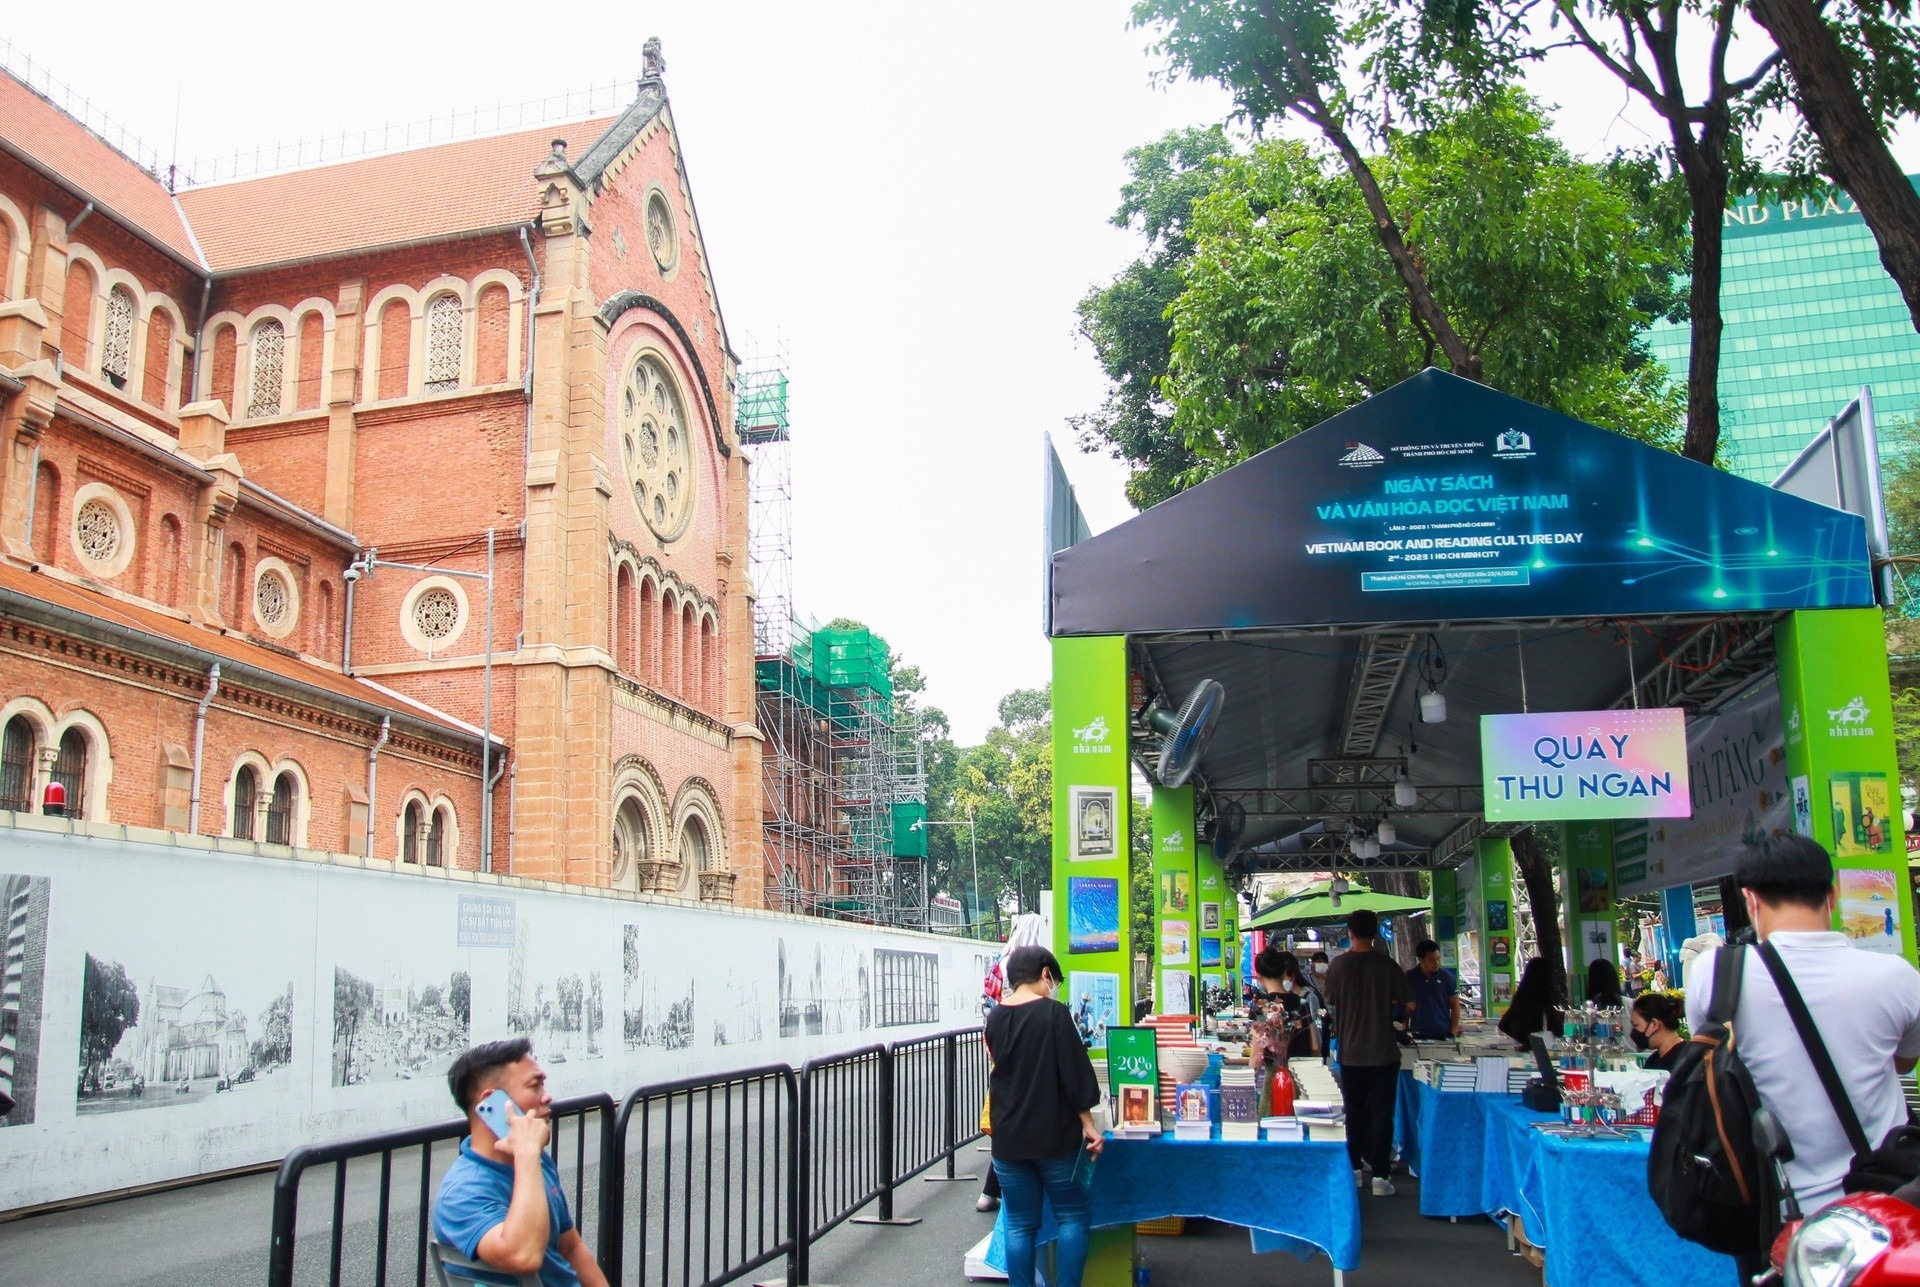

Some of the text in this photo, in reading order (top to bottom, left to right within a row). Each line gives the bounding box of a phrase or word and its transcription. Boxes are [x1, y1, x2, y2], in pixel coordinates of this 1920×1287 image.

[1723, 194, 1861, 227] ND PLAZ
[1384, 474, 1494, 494] NGÀY SÁCH
[1316, 494, 1568, 520] VÀ VĂN HÓA ĐỌC VIỆT NAM
[1306, 533, 1583, 554] VIETNAM BOOK AND READING CULTURE DAY
[1851, 727, 1874, 736] nam
[1092, 745, 1111, 754] nam
[1496, 768, 1672, 800] THU NGÂN
[1690, 747, 1712, 810] UÀ
[1113, 1056, 1152, 1071] -20%
